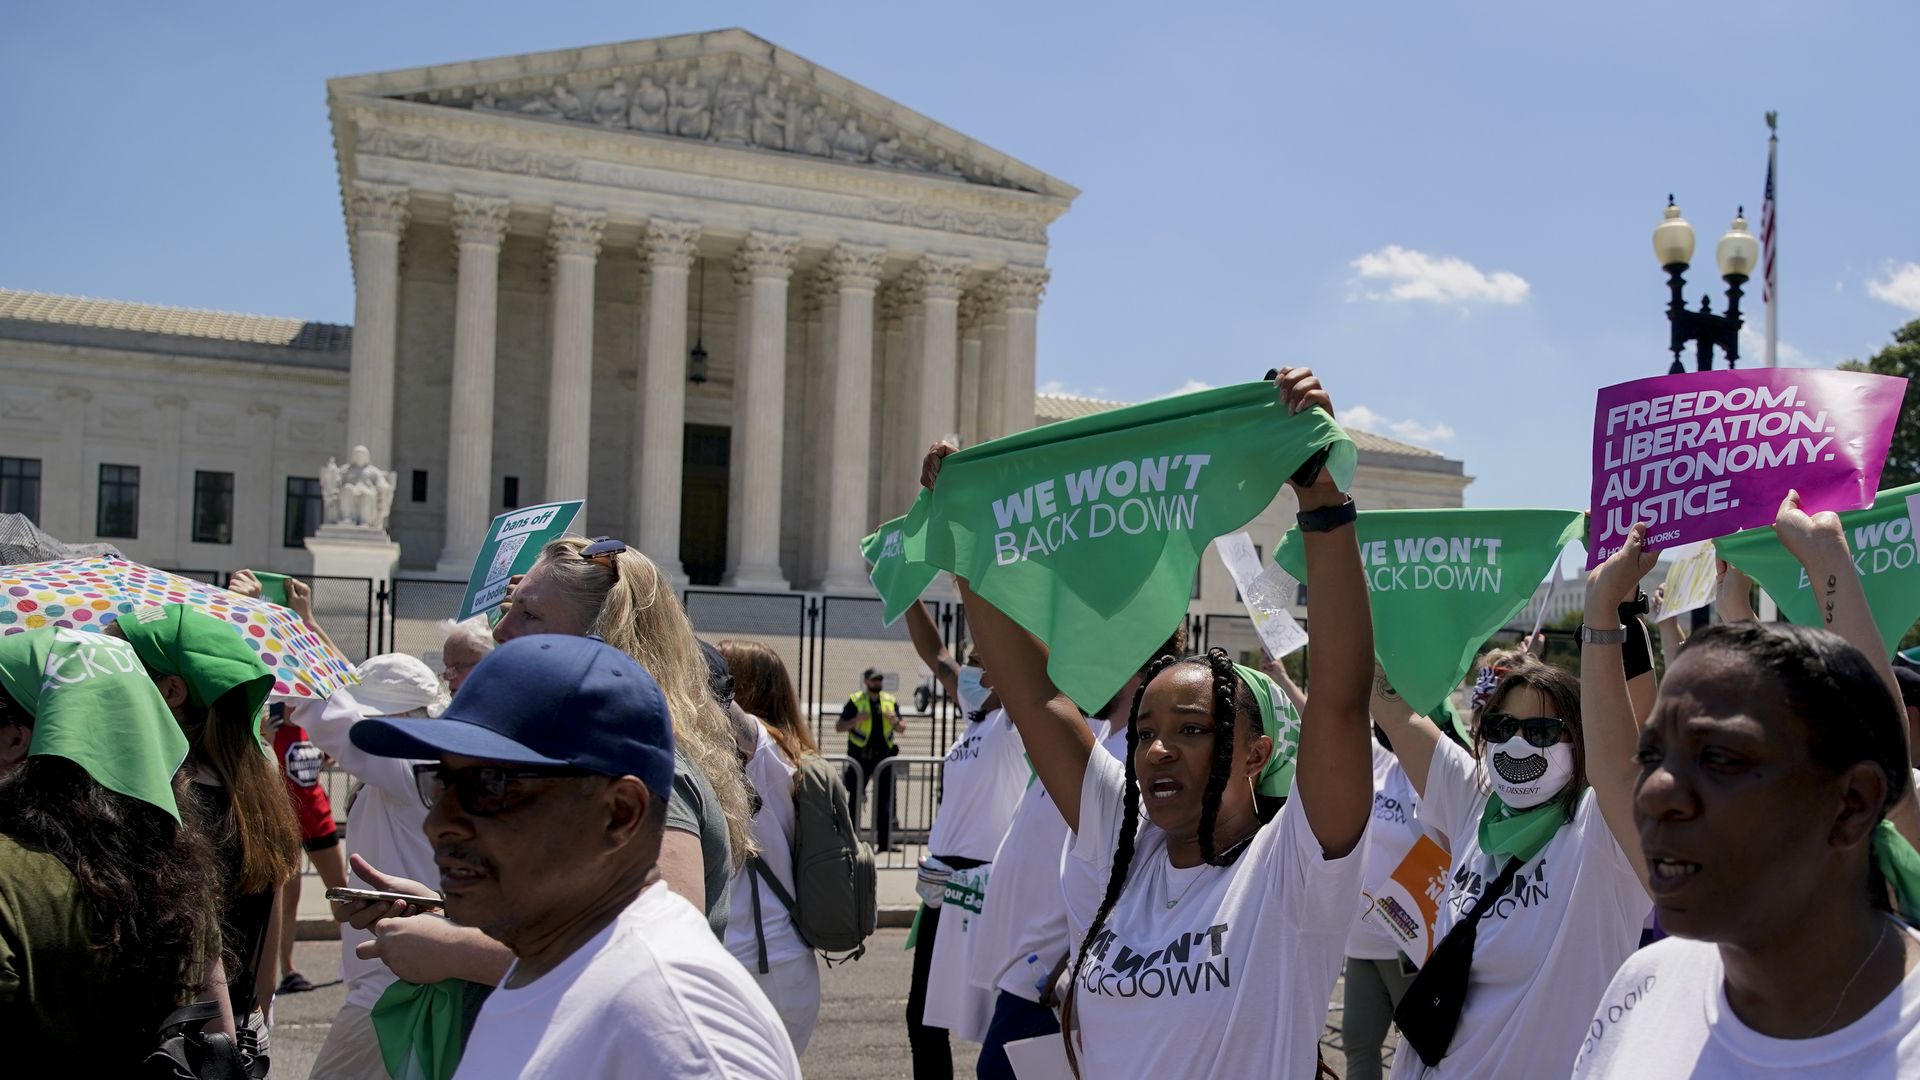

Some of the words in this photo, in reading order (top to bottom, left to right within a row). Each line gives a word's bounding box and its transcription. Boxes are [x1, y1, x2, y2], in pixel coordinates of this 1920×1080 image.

[1606, 385, 1806, 436] FREEDOM.
[1604, 411, 1835, 470] LIBERATION.
[1601, 437, 1835, 506] AUTONOMY.
[992, 486, 1057, 529] WE
[1065, 454, 1211, 506] WON'T
[502, 517, 530, 533] bans
[531, 511, 554, 525] off
[1600, 479, 1740, 541] JUSTICE.
[994, 508, 1082, 566] BACK
[1089, 494, 1199, 538] DOWN
[1647, 530, 1680, 546] WORKS
[1854, 517, 1915, 550] WO
[1394, 537, 1502, 565] WON'T
[1873, 543, 1916, 574] DO
[1363, 566, 1408, 592] ACK
[1414, 565, 1502, 593] DOWN
[945, 746, 979, 761] OWN
[1506, 786, 1540, 794] DISSENT
[944, 888, 963, 900] our
[1081, 957, 1117, 997] ACK
